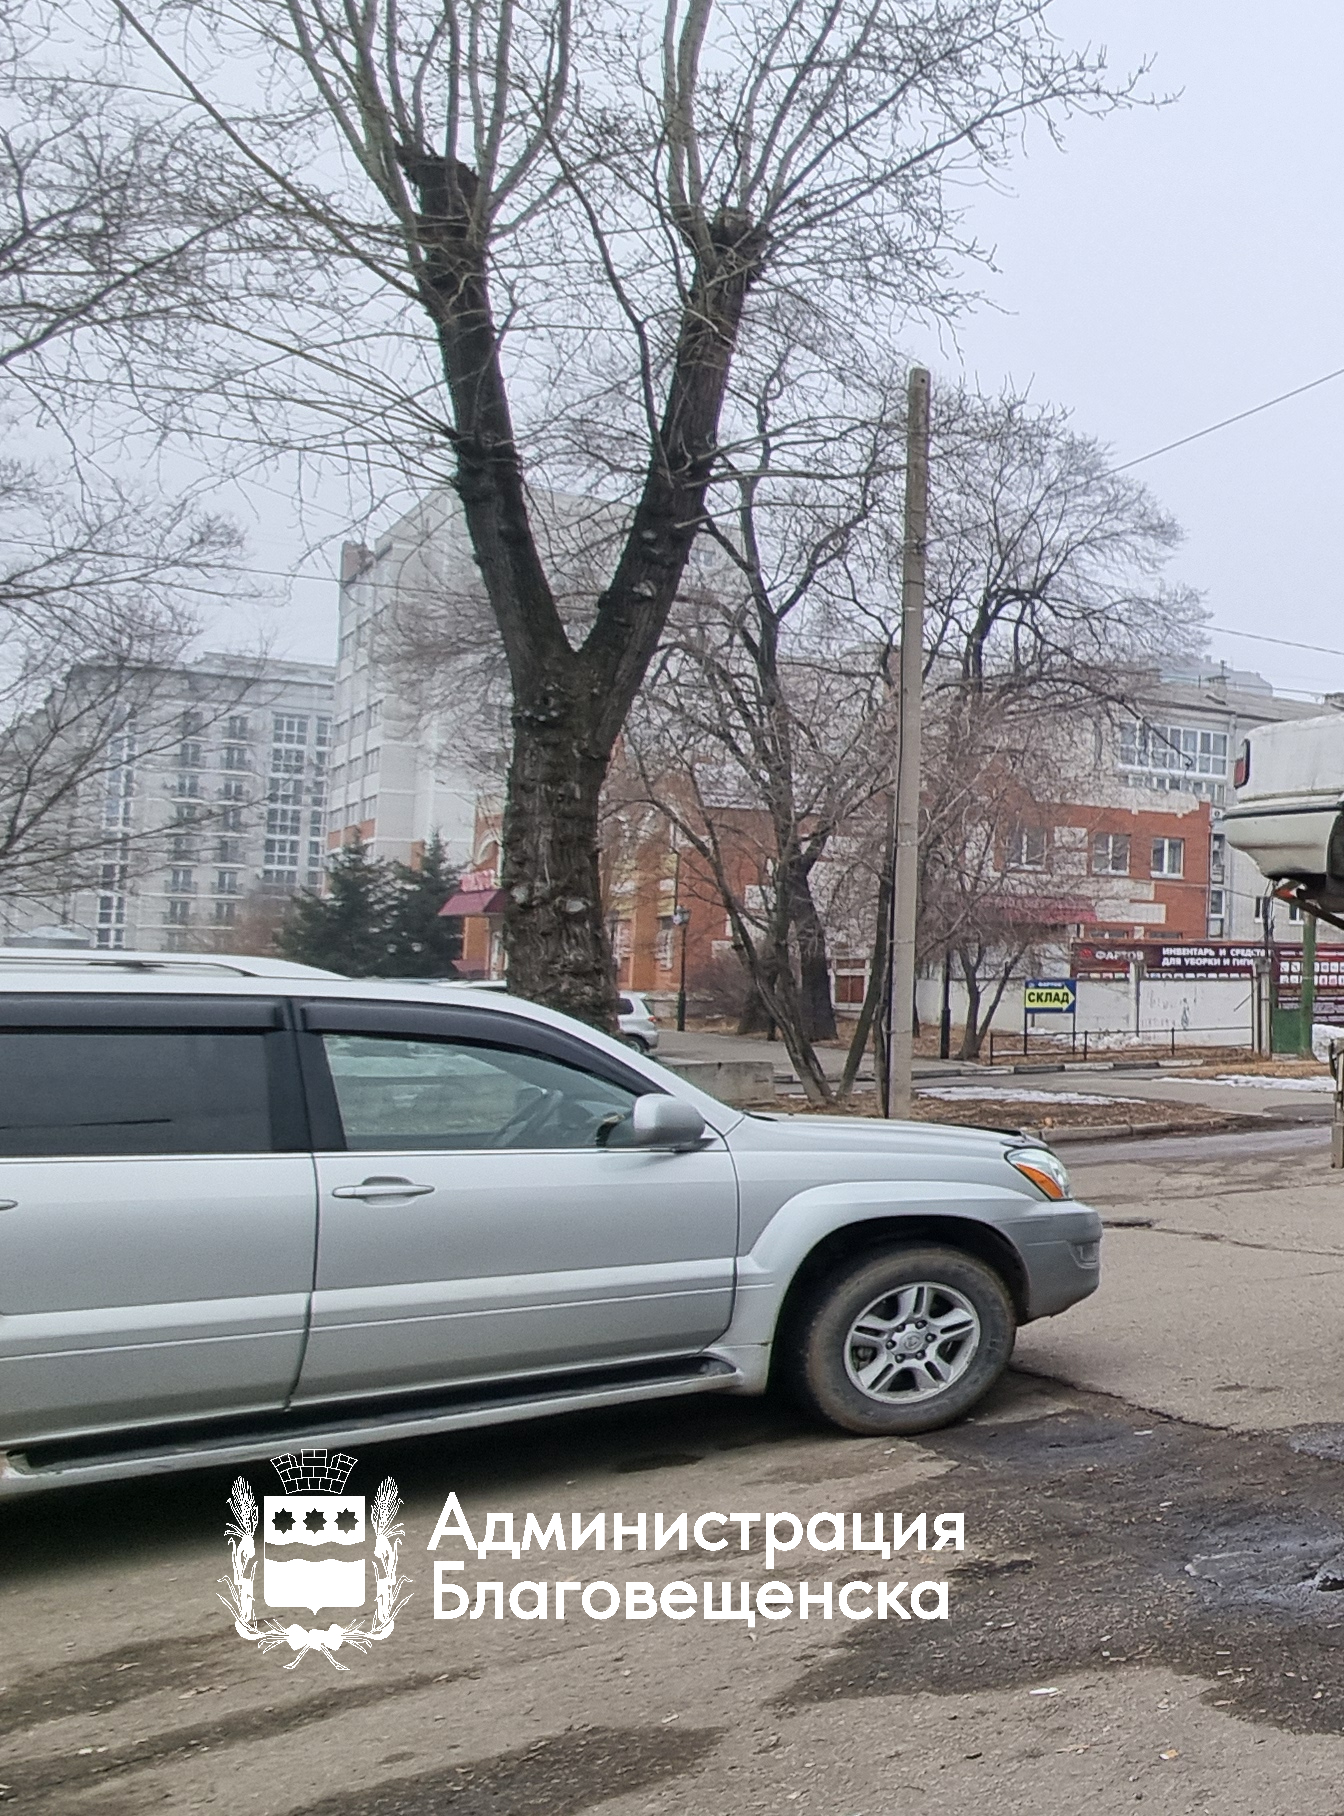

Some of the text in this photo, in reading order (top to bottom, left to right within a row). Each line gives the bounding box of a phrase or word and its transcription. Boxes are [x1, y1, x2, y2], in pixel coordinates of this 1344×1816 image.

[1095, 950, 1144, 961] ФАРТОВ
[1162, 947, 1215, 956] ИНВЕНТАРЬ
[1218, 948, 1227, 956] И
[1161, 957, 1182, 967] ДЛЯ
[1184, 957, 1221, 966] УБОРКИ
[1222, 957, 1230, 966] И
[1027, 991, 1070, 1005] СКЛАД
